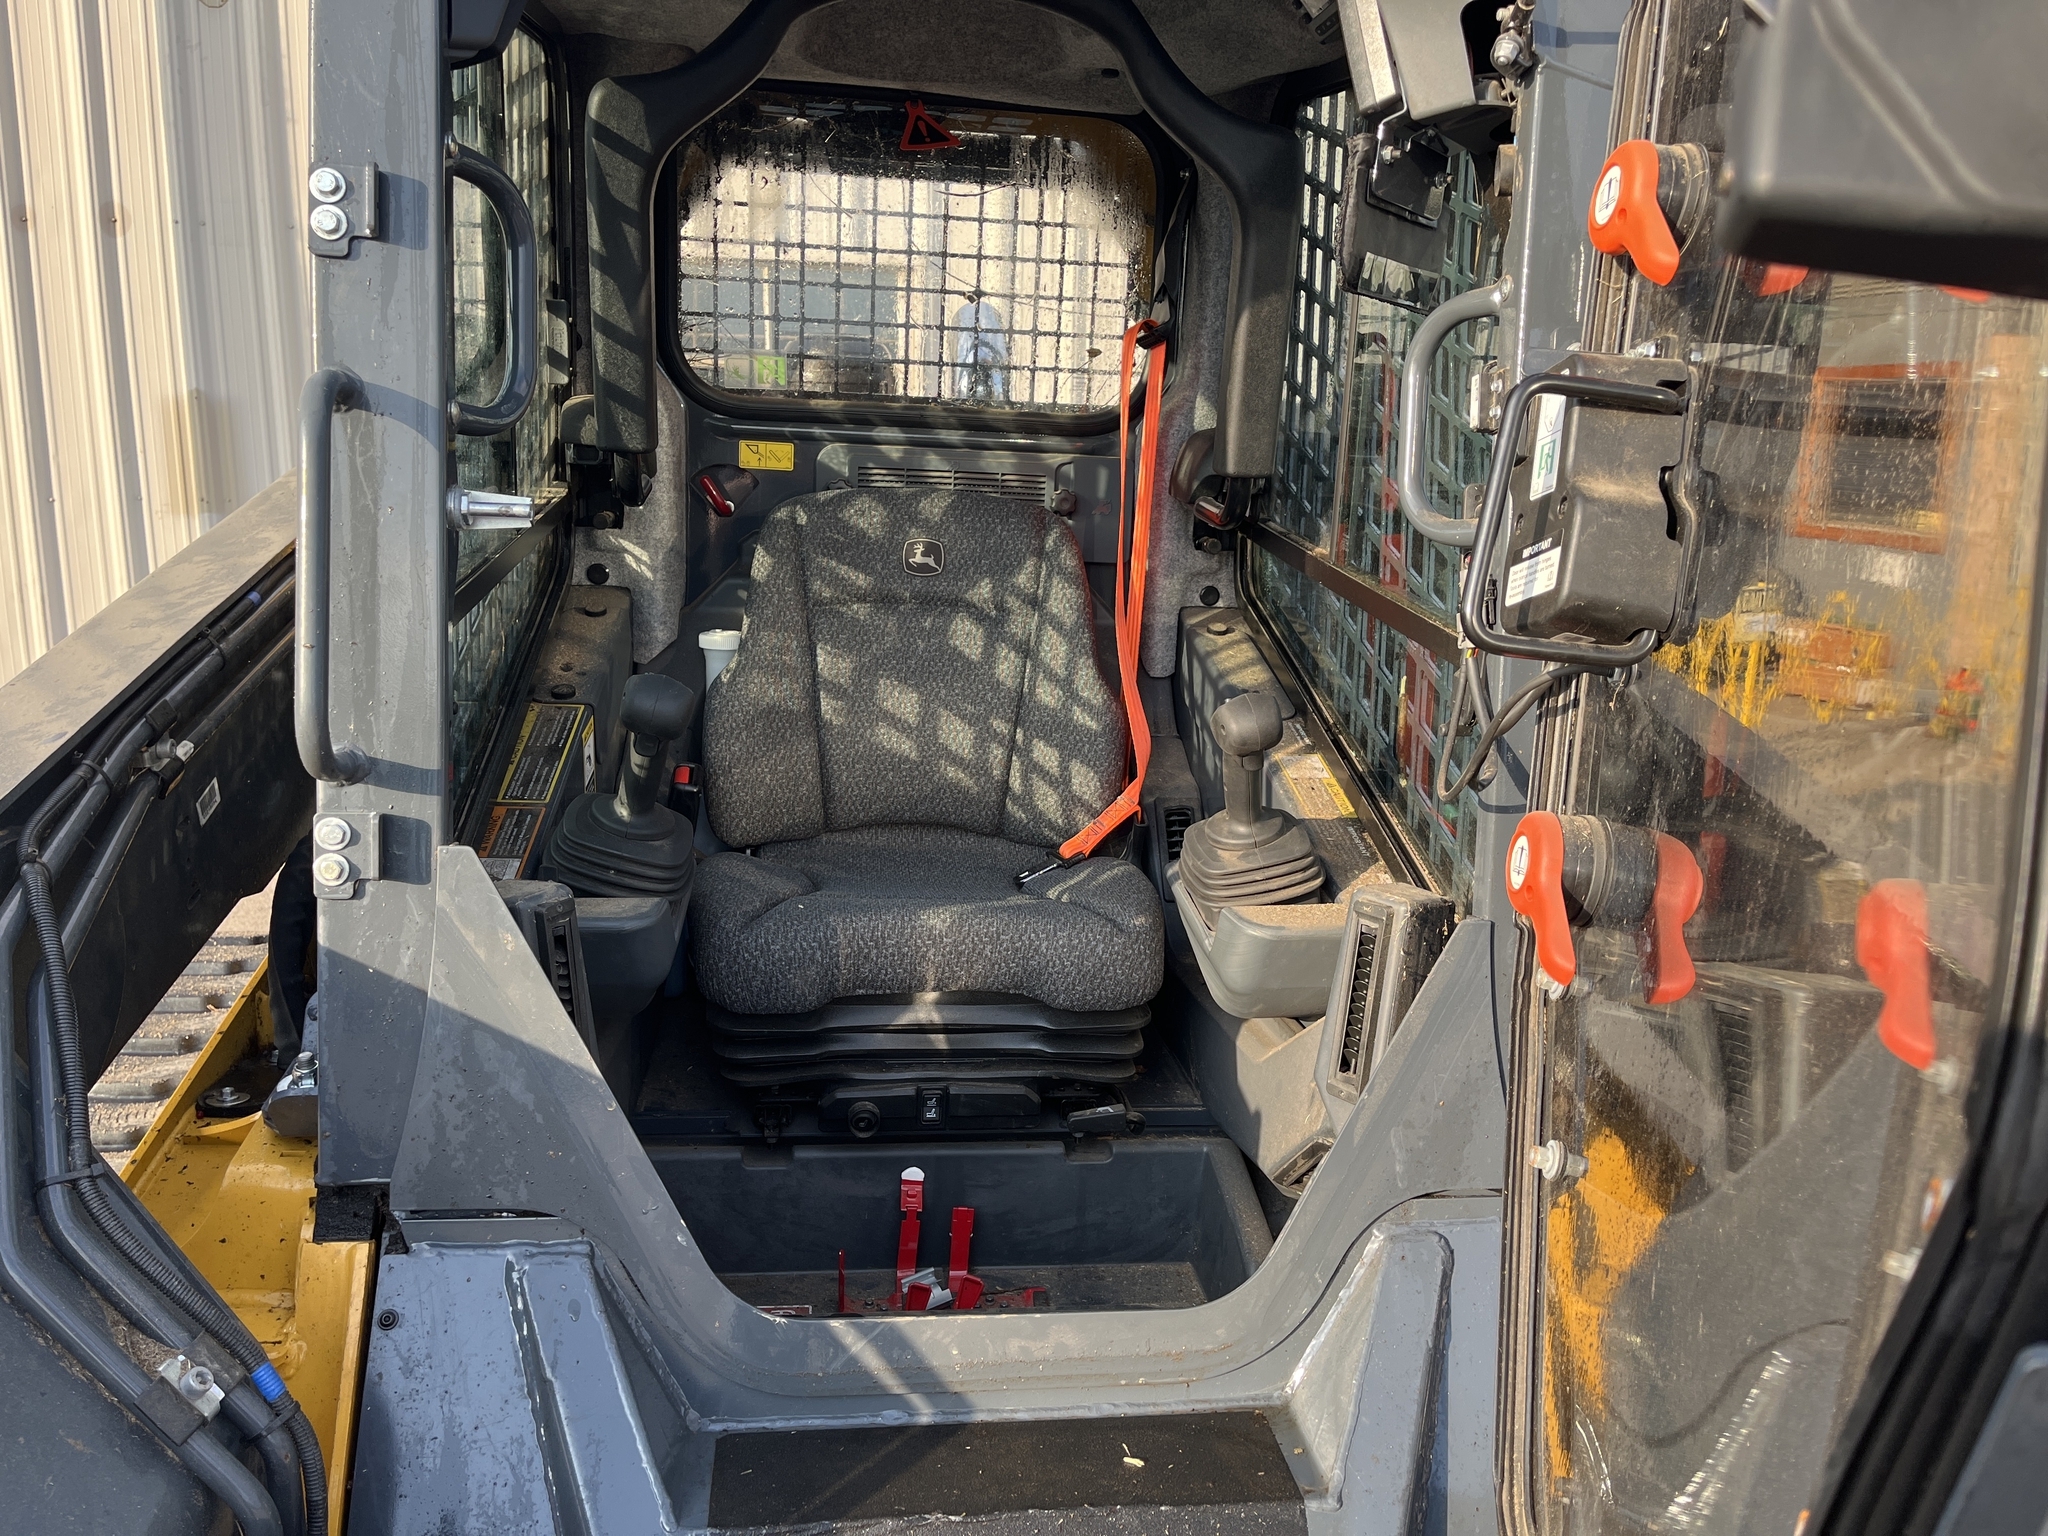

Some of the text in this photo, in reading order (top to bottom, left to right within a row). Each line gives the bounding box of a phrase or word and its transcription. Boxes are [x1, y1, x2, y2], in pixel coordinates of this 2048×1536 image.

[1522, 537, 1552, 558] IMPORTANT
[1330, 785, 1351, 814] CAUTION
[482, 815, 501, 847] WARNING
[1347, 826, 1370, 857] IMPORTANT
